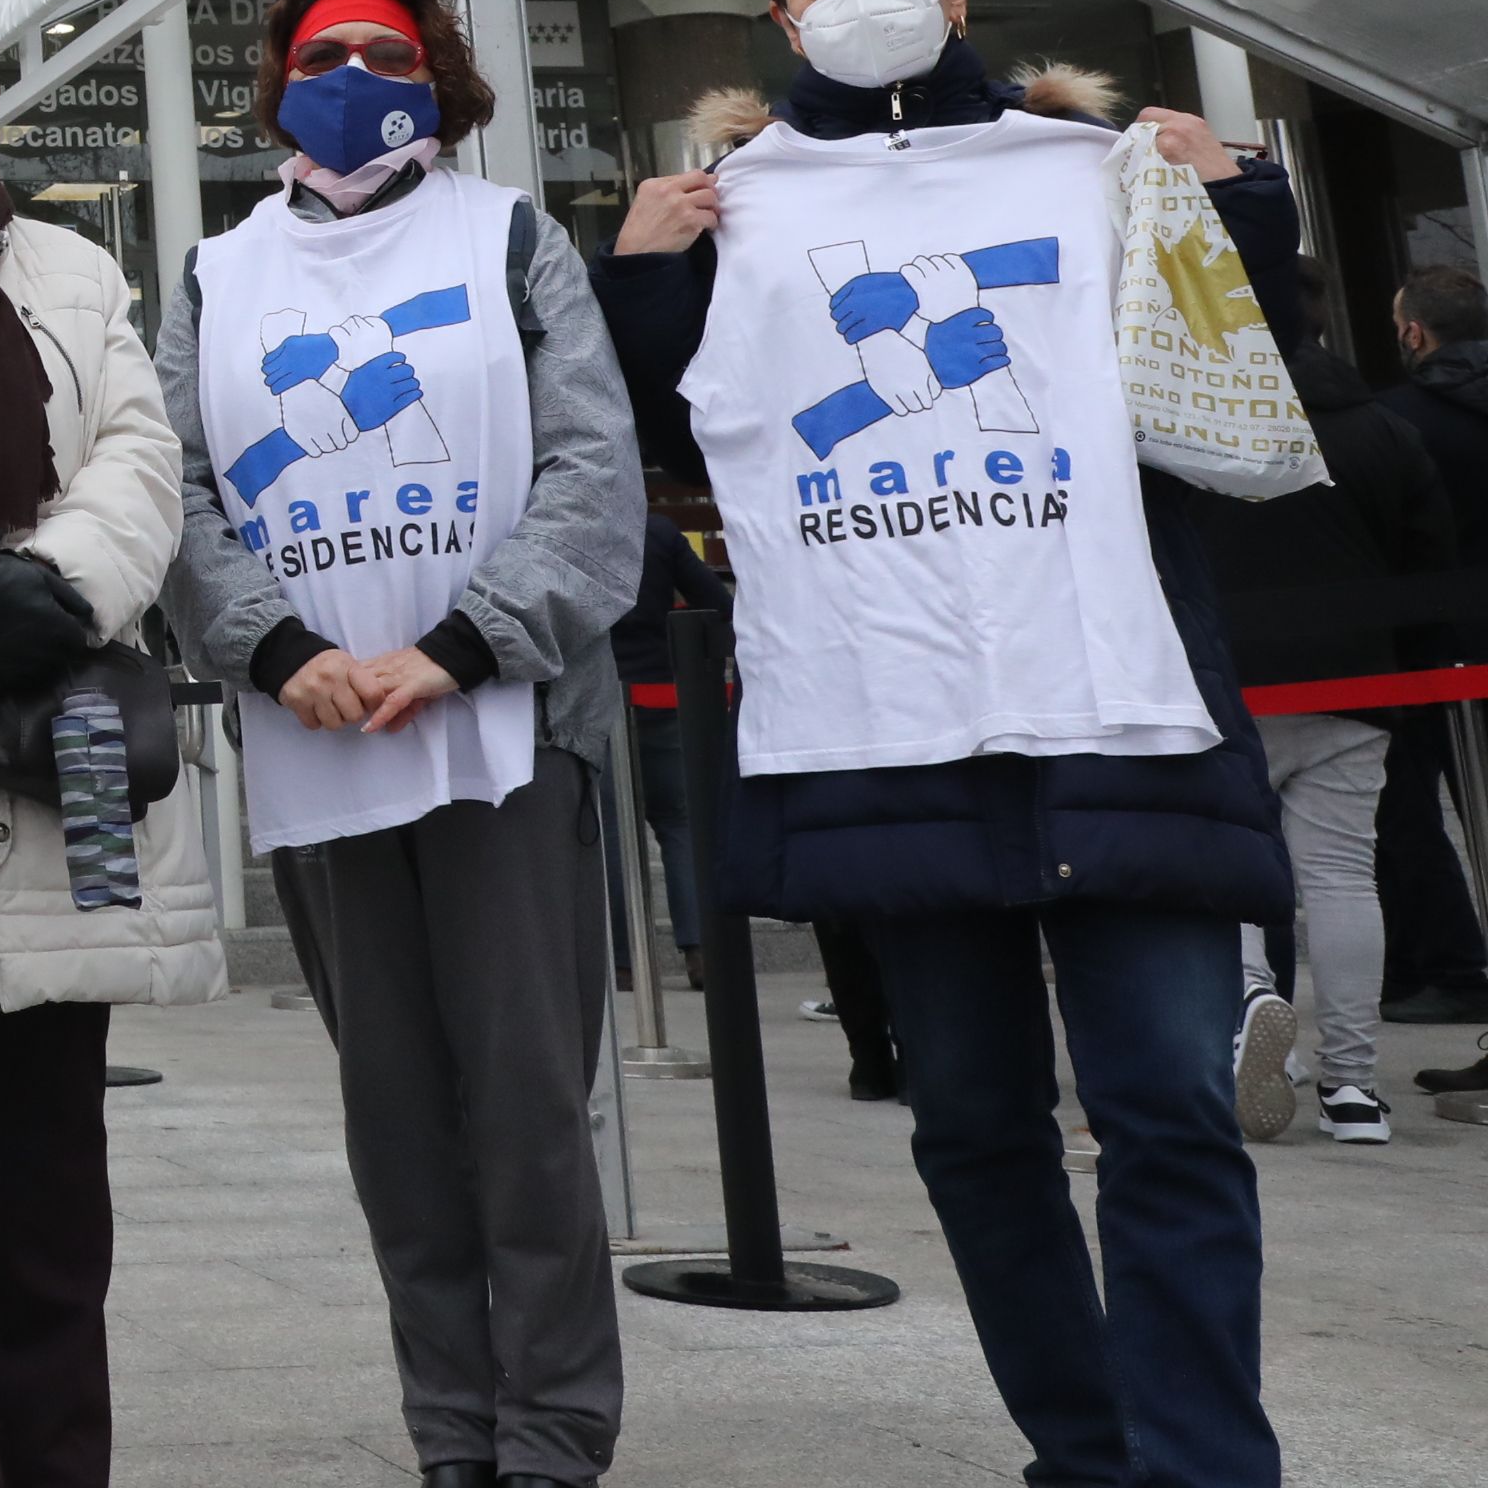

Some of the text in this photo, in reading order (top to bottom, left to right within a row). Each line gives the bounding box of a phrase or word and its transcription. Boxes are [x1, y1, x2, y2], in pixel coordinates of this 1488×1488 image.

[1170, 362, 1280, 391] OTOÑO
[1192, 391, 1310, 422] OTOÑ
[1252, 438, 1322, 457] OTOÑ
[796, 448, 1072, 508] marea
[239, 481, 479, 553] marea
[799, 489, 1069, 547] RESIDENCIAS
